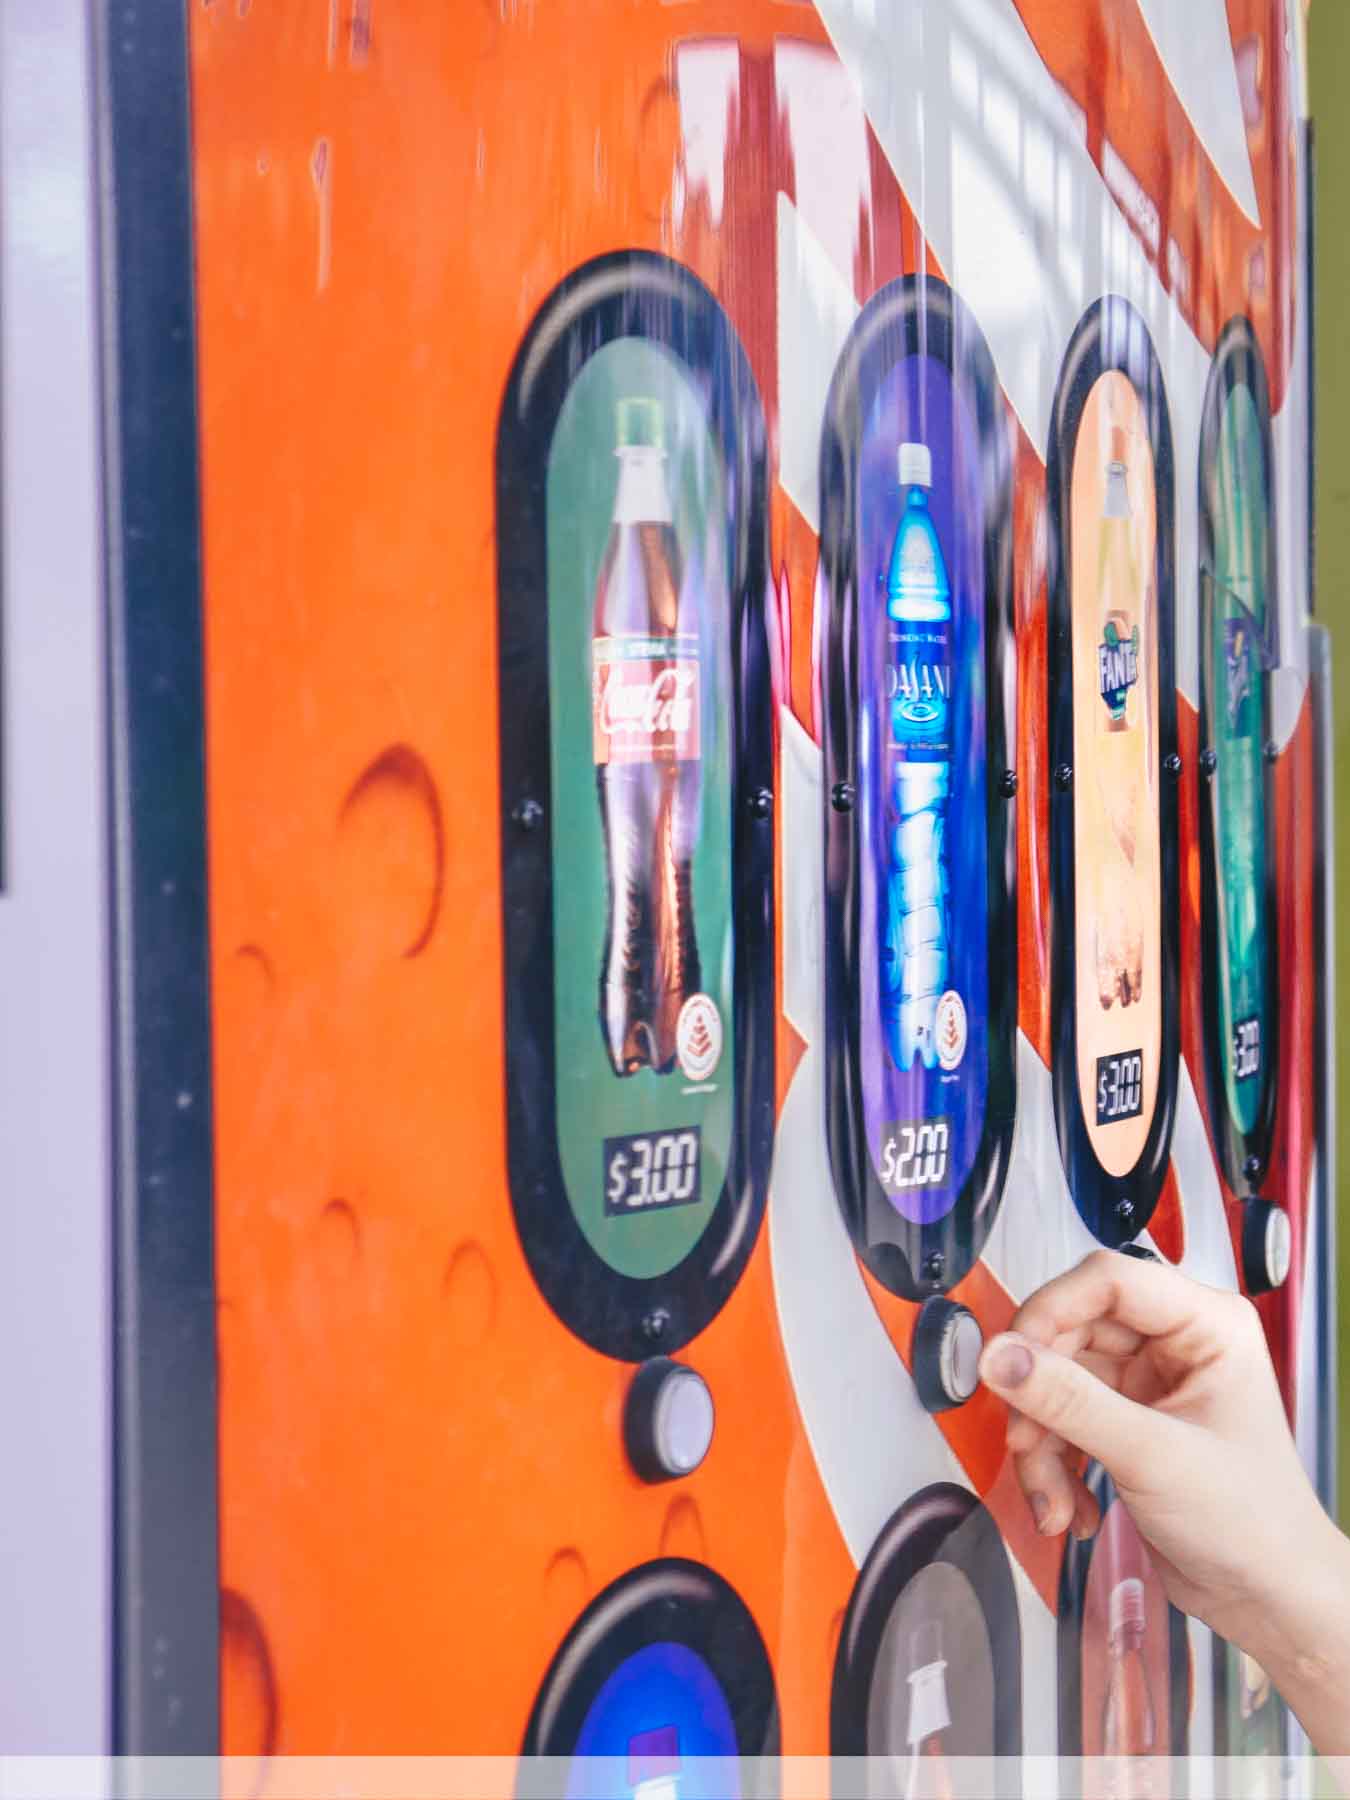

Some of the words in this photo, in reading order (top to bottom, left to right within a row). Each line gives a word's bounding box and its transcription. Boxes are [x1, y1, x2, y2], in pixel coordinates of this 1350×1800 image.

[887, 653, 951, 702] DASANI
[1098, 1056, 1142, 1116] $3.00
[607, 1132, 698, 1206] $3.00
[880, 1123, 949, 1188] $2.00
